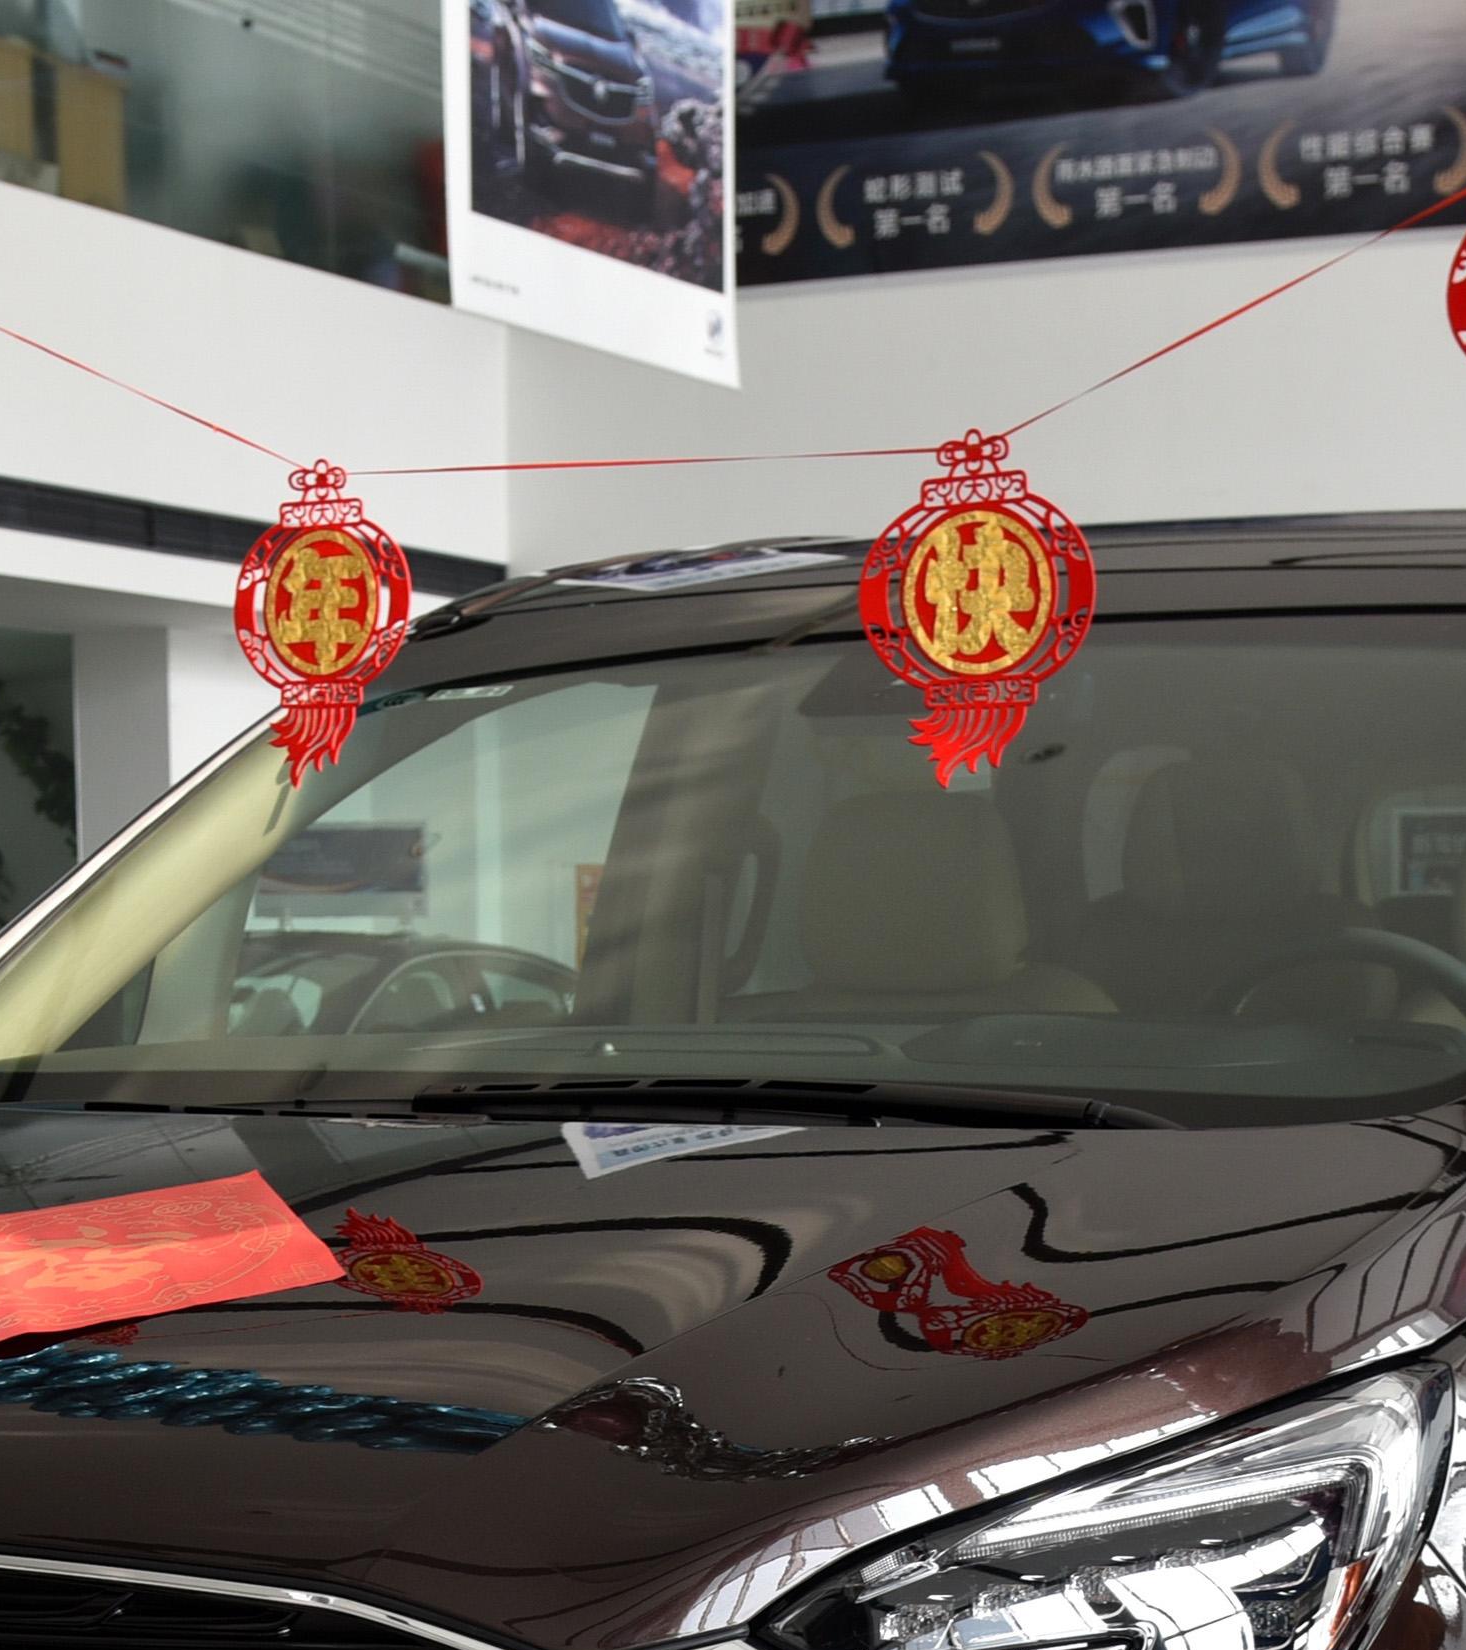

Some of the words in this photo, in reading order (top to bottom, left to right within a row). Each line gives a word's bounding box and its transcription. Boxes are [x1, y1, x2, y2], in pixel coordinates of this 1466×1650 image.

[1094, 181, 1179, 219] 第一名
[1323, 160, 1411, 200] 第一名
[873, 203, 951, 240] 第一名
[924, 522, 1035, 656] 快
[277, 547, 361, 672] 年
